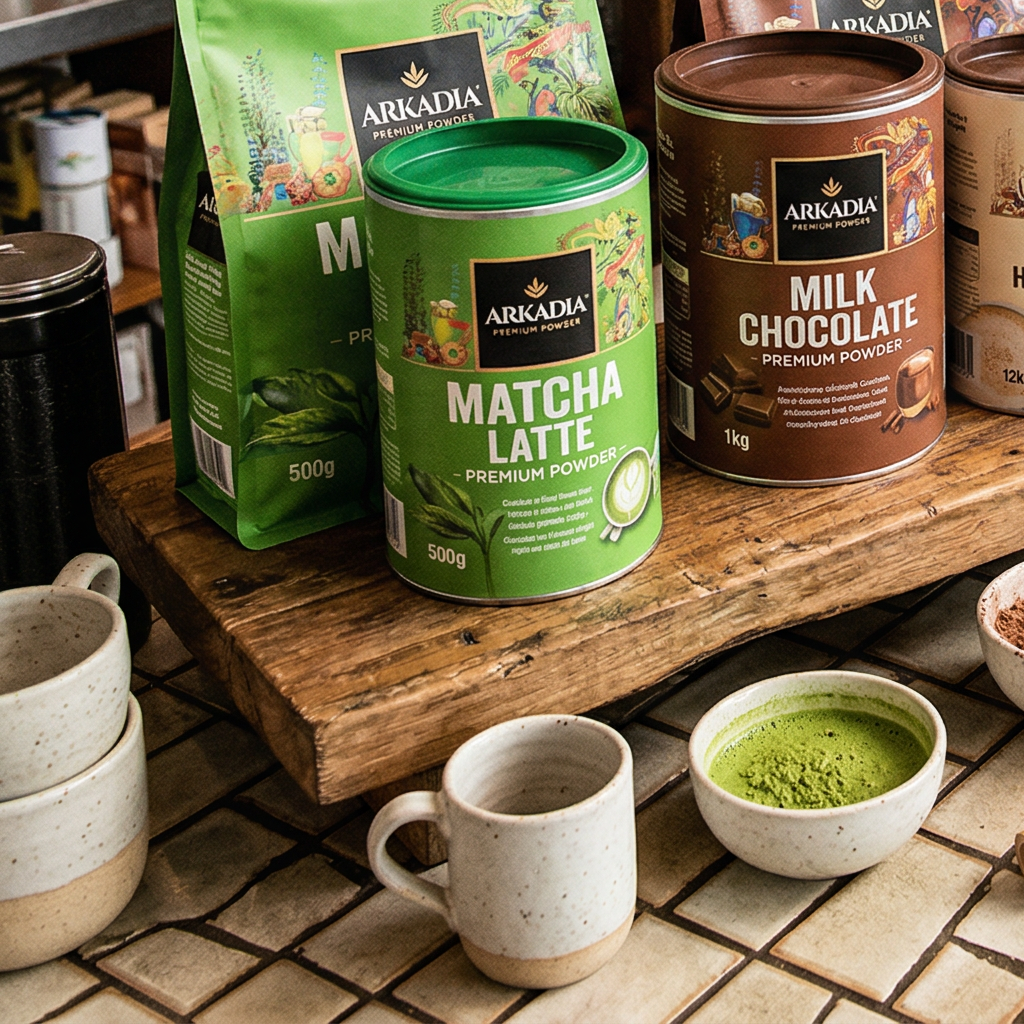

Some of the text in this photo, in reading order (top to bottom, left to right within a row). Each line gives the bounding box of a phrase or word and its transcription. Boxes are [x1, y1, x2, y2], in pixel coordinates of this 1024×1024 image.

[830, 9, 933, 35] ARKADIA
[361, 85, 484, 128] ARKADIA
[372, 123, 424, 141] PREMIUM
[784, 196, 878, 221] ARKADIA
[790, 267, 877, 311] MILK
[485, 295, 588, 325] ARKADIA
[738, 293, 918, 349] CHOCOLATE
[762, 339, 903, 367] PREMIUM POWDER
[447, 360, 624, 425] MATCHA
[487, 415, 595, 464] LATTE
[724, 428, 750, 452] 1kg
[289, 458, 336, 483] 500g
[465, 446, 617, 484] PREMIUM POWDER
[427, 542, 467, 570] 500g
